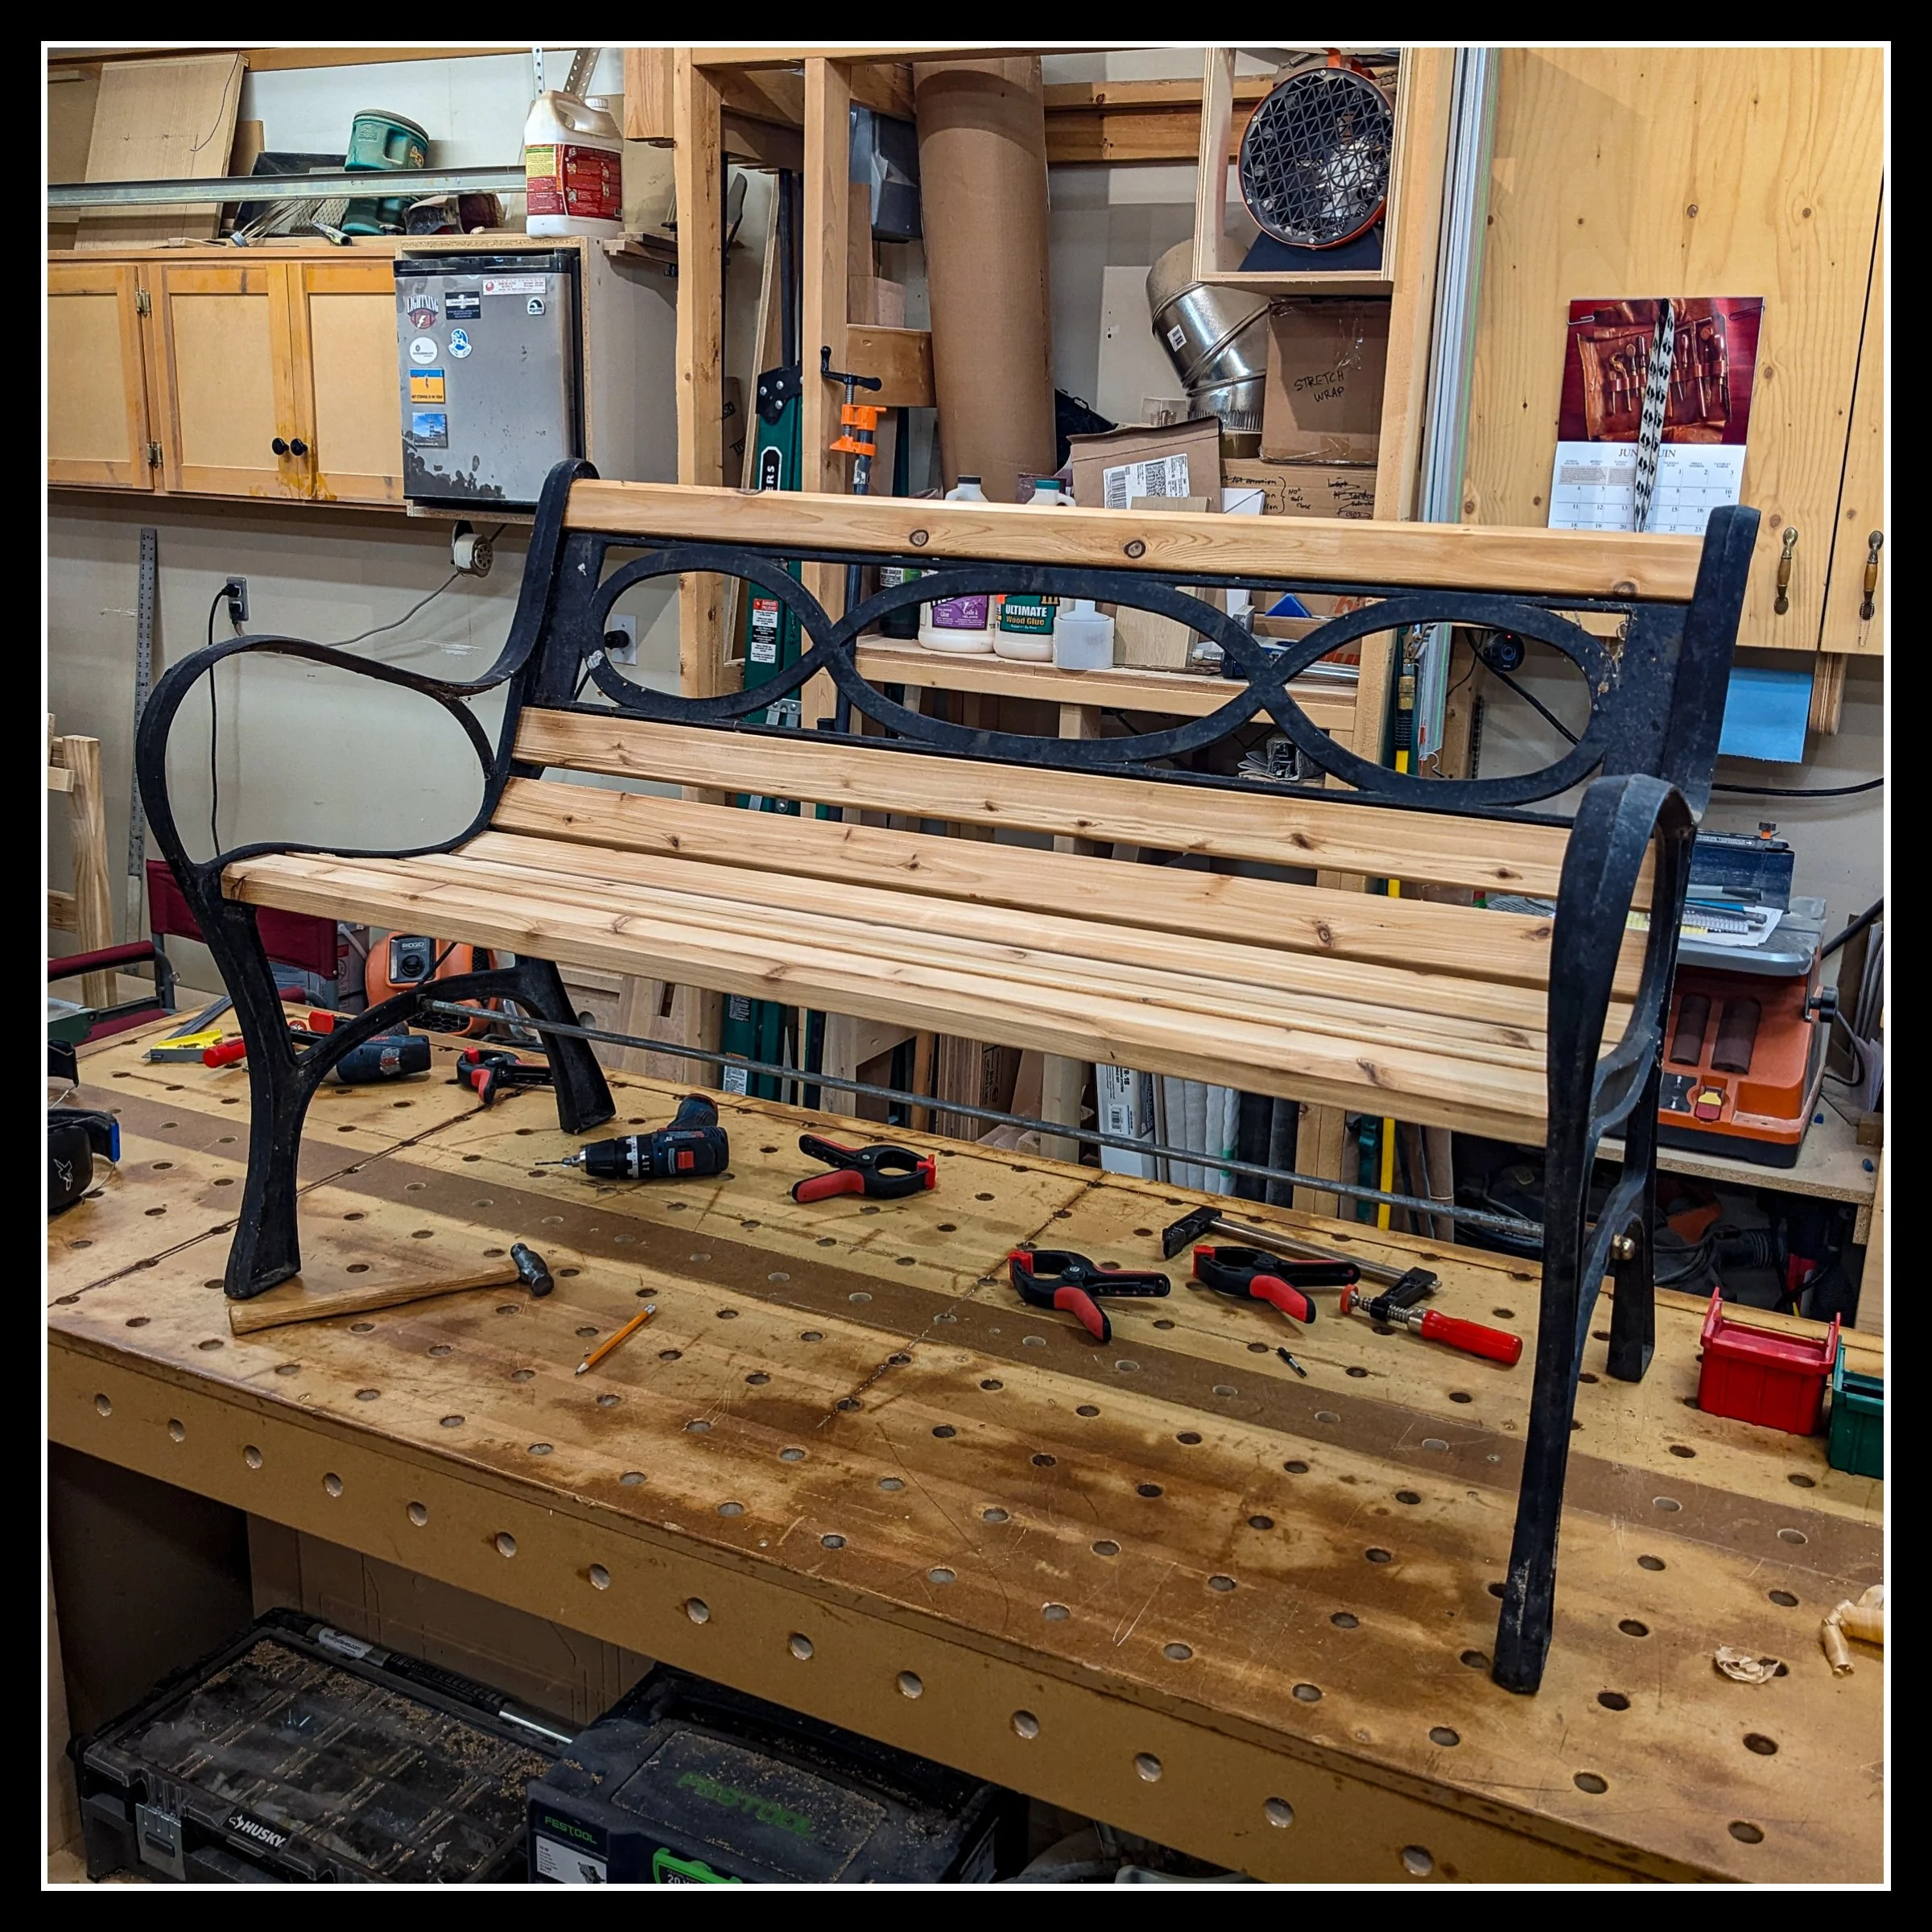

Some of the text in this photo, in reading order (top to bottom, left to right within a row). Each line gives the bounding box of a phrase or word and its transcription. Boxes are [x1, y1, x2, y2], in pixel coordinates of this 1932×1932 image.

[407, 294, 440, 313] LIGHTNING
[1294, 370, 1344, 392] STRETCH
[1313, 386, 1344, 402] WRAP
[1619, 448, 1676, 457] JUN UIN
[1005, 604, 1047, 617] ULTIMATE
[1006, 615, 1045, 625] Wood Glue
[242, 1820, 287, 1847] HUSKY
[545, 1815, 597, 1844] FESTOOL
